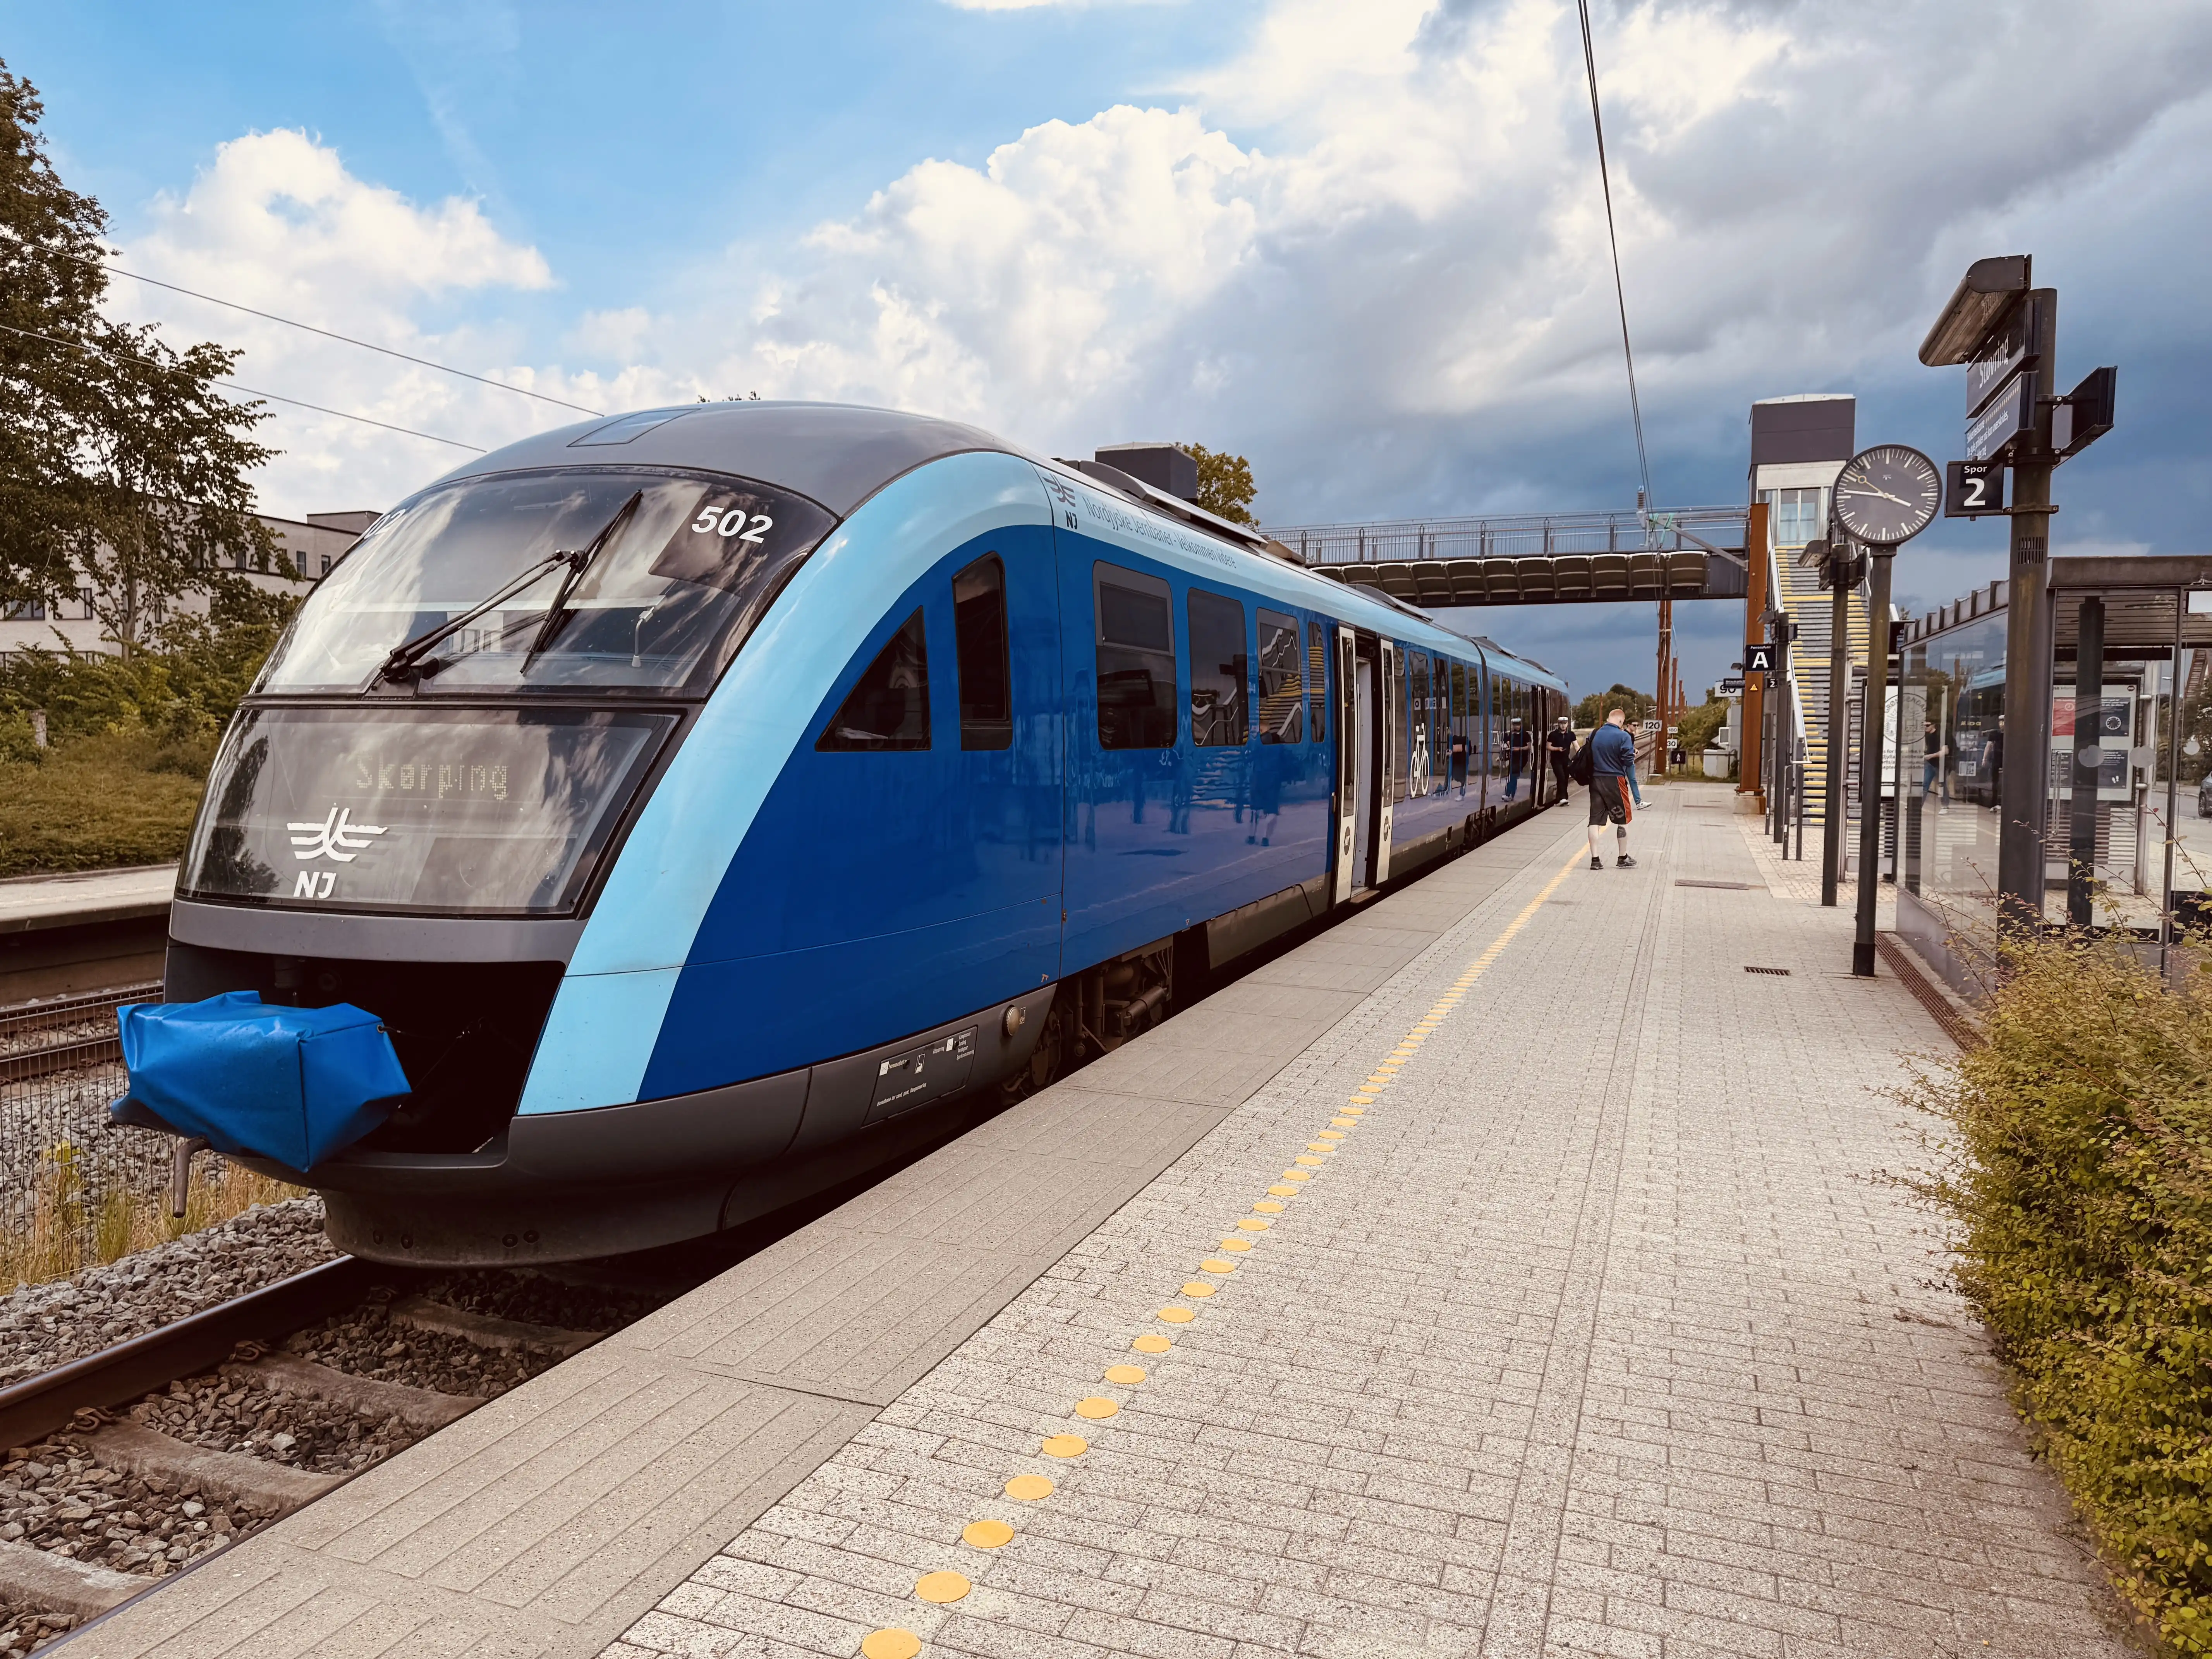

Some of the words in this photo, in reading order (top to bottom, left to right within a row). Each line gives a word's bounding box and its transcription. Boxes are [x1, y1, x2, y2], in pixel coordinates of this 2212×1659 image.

[1964, 465, 1987, 474] Spor
[1964, 478, 1985, 506] 2
[692, 506, 773, 544] 502
[1065, 510, 1078, 530] NJ
[1082, 496, 1133, 531] Nordjyske
[1131, 515, 1173, 546] Jernbaner
[1174, 532, 1218, 562] Velkommen
[1216, 549, 1237, 568] videre
[1752, 652, 1769, 668] A
[293, 871, 337, 898] NJ
